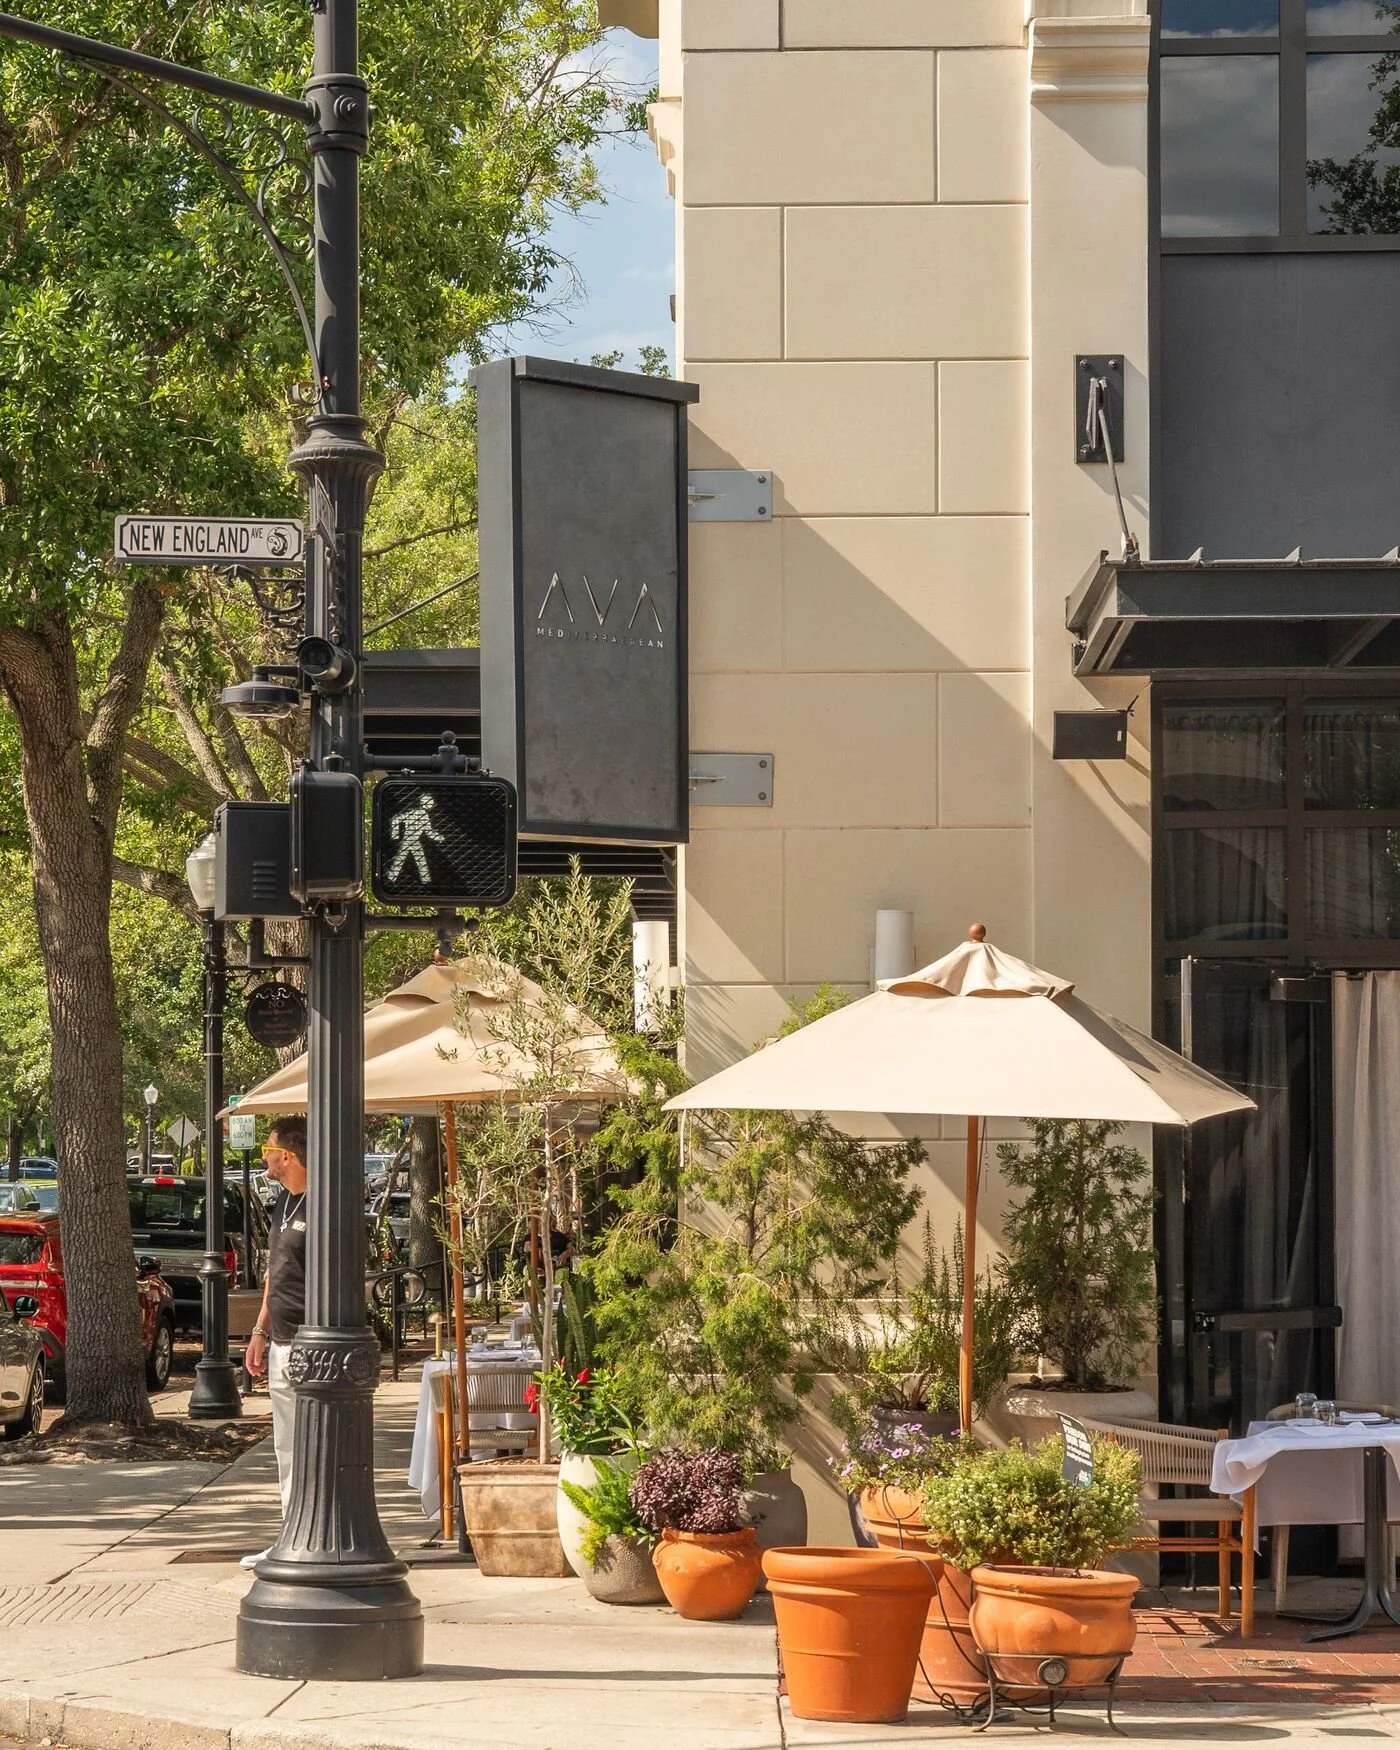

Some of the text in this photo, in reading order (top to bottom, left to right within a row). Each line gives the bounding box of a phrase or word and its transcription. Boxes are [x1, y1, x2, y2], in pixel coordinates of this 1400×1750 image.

[130, 525, 264, 553] NEW ENGLAND AVE
[537, 571, 662, 633] AVA
[268, 1000, 285, 1008] NO
